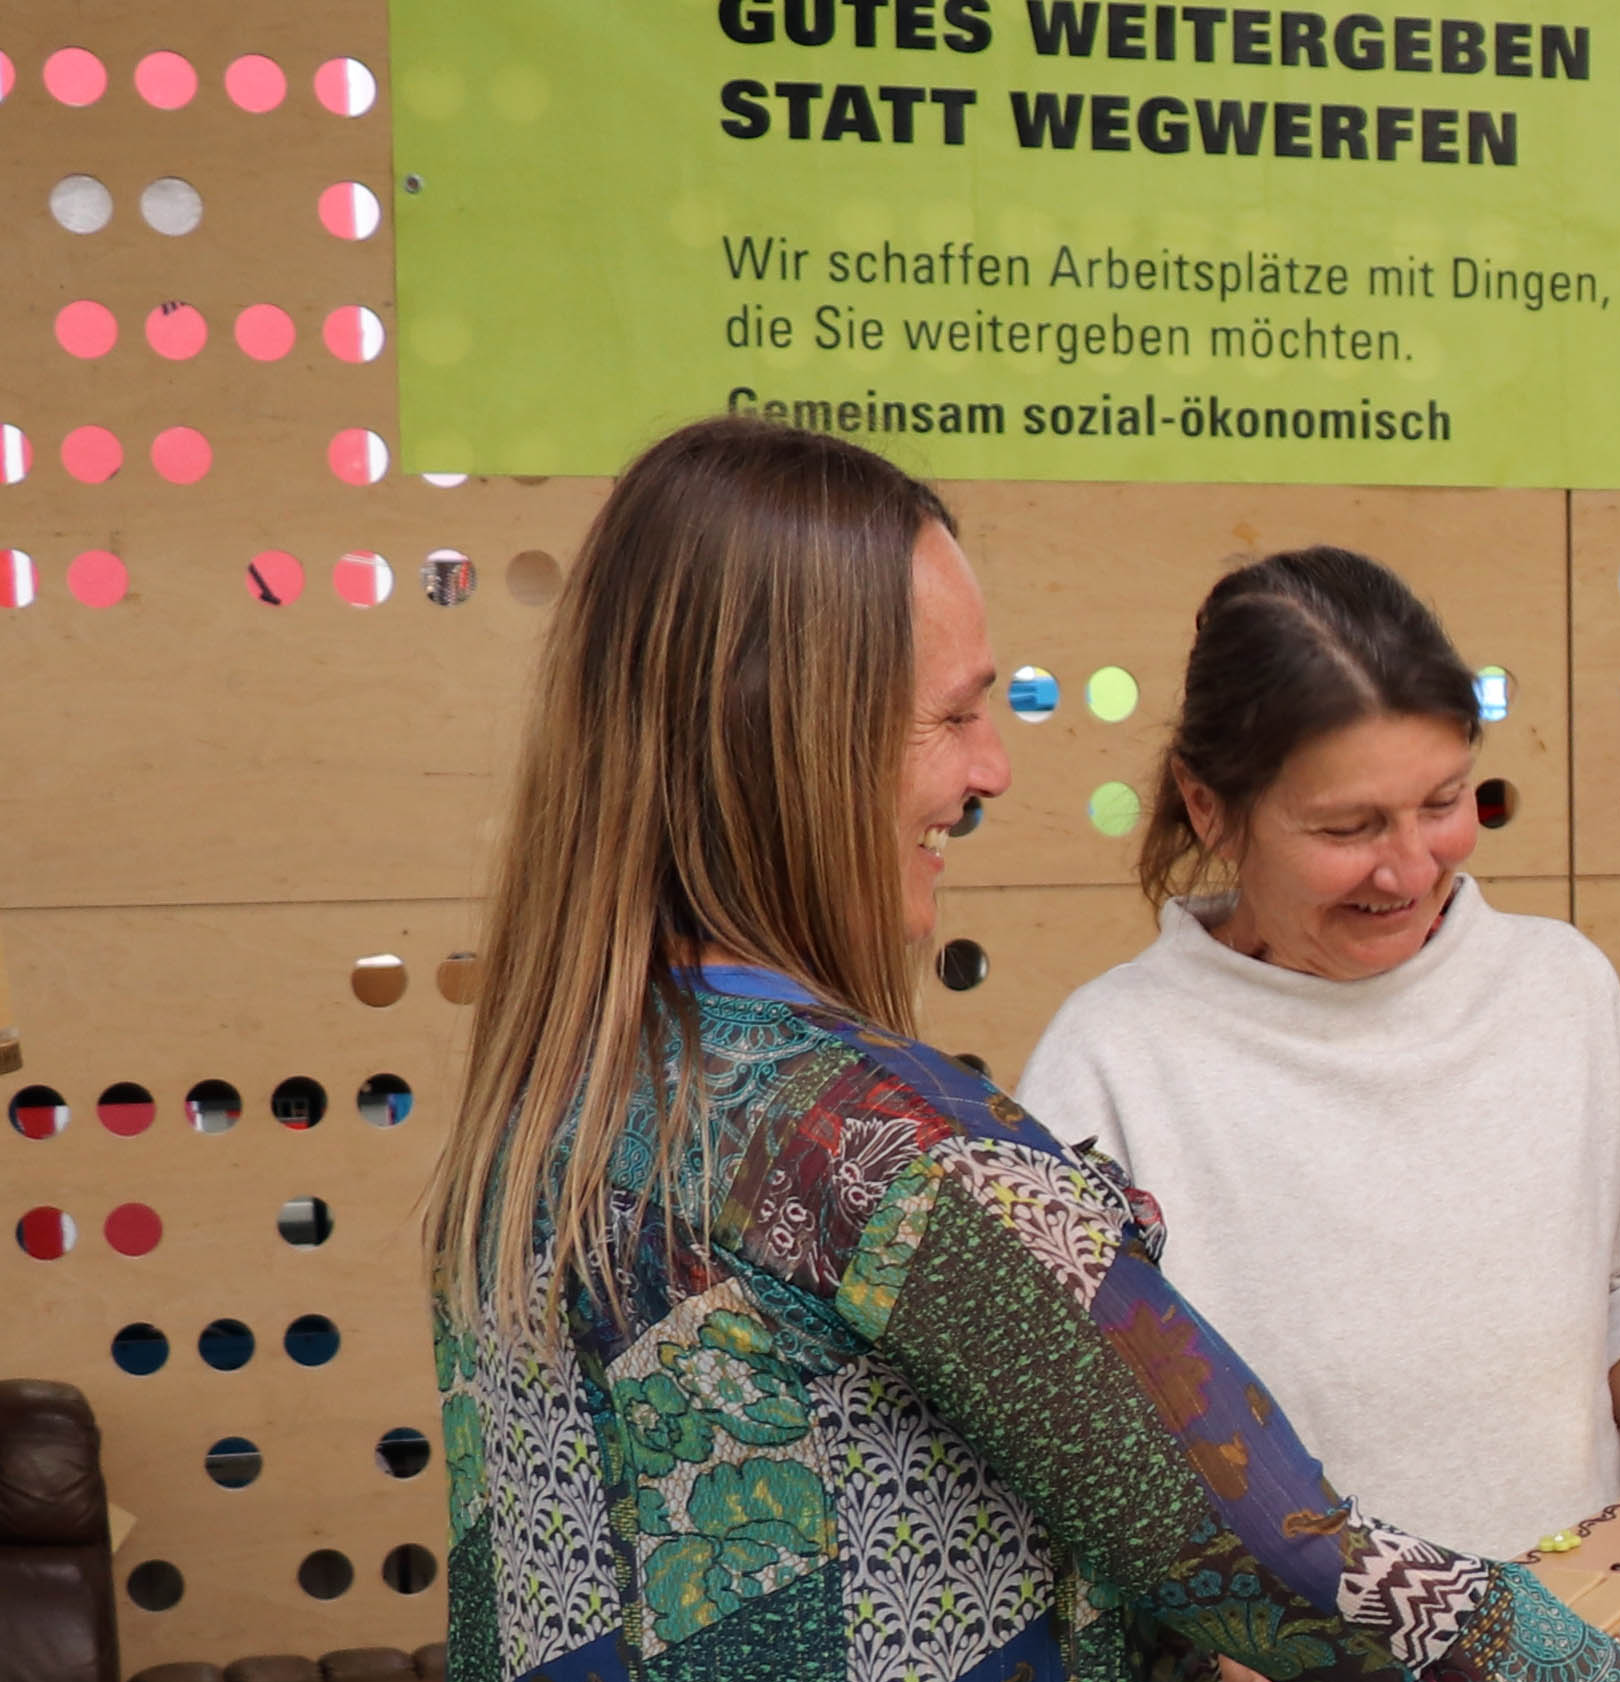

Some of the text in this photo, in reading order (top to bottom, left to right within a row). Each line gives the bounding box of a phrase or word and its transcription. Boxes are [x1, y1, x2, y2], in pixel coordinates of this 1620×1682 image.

[718, 0, 993, 53] GUTES
[1026, 0, 1590, 80] WEITERGEBEN
[720, 78, 1518, 166] STATT WEGWERFEN
[722, 236, 1610, 311] Wir schaffen Arbeitsplätze mit Dingen,
[726, 304, 1414, 365] die Sie weitergeben möchten.
[1023, 394, 1452, 441] sozial-ökonomisch
